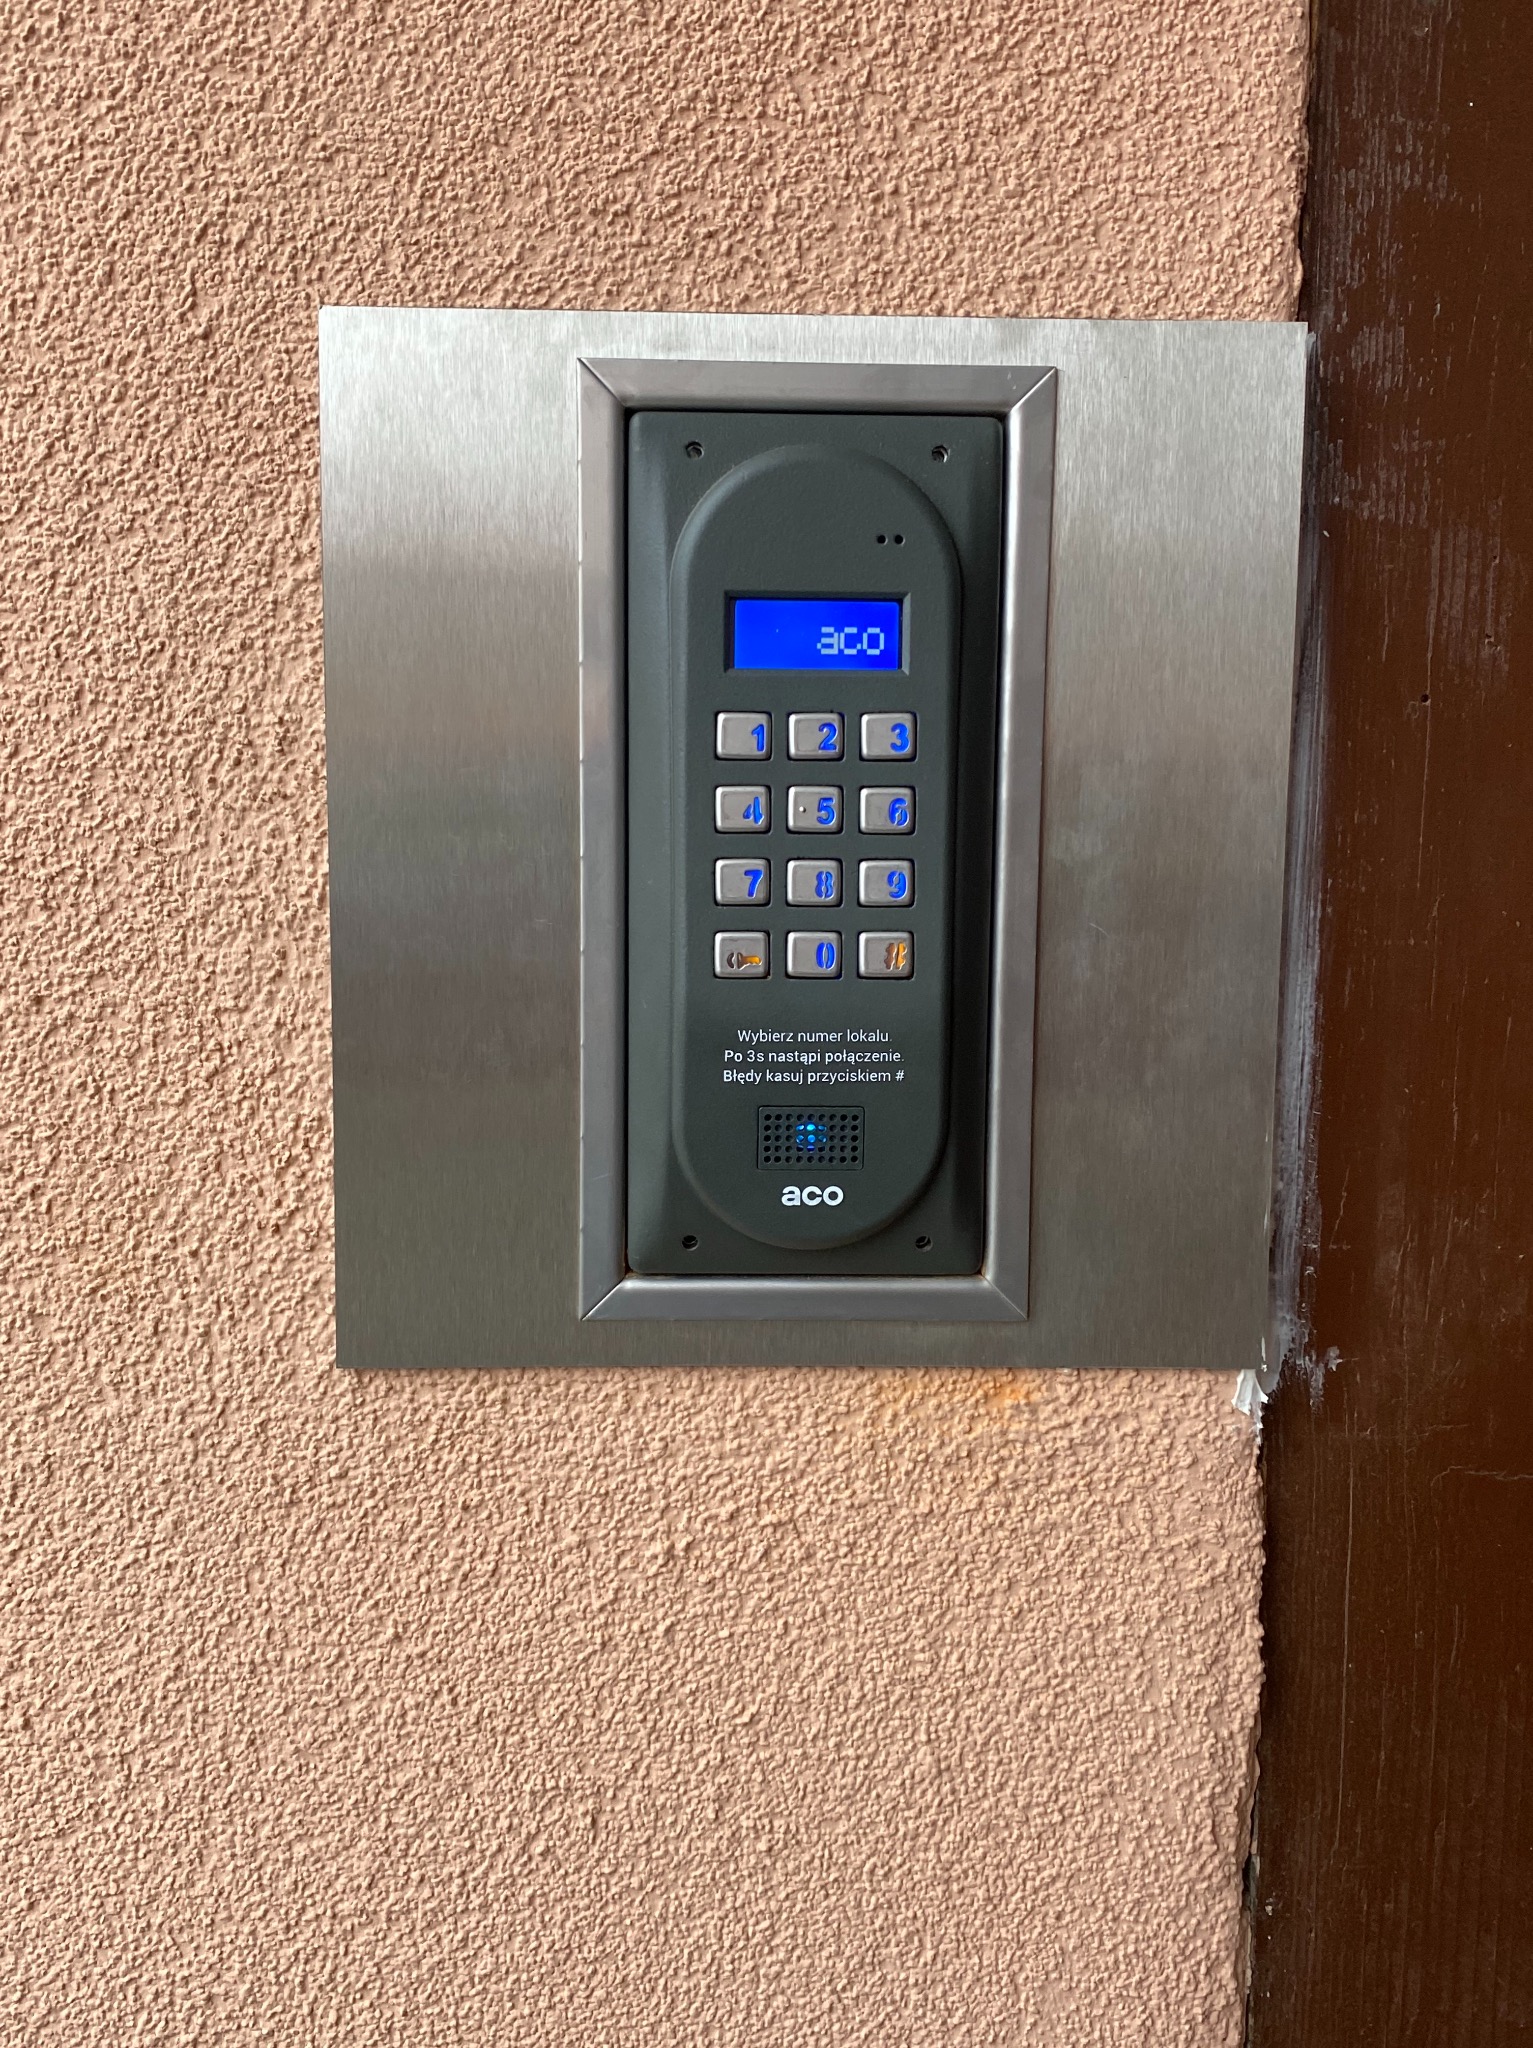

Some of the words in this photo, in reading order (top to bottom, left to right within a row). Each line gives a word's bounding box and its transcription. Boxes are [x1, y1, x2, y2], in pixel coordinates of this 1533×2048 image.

[816, 626, 885, 656] aco
[751, 723, 766, 753] 1
[818, 722, 838, 753] 2
[890, 722, 910, 753] 3
[743, 796, 764, 825] 4
[817, 797, 836, 826] 5
[888, 797, 909, 827] 6
[744, 868, 764, 898] 7
[815, 870, 834, 900] 8
[886, 870, 908, 900] 9
[815, 941, 837, 970] 0
[737, 1028, 794, 1046] Wybierz
[797, 1032, 844, 1042] numer
[846, 1028, 893, 1042] lokalu.
[724, 1049, 743, 1062] Po
[746, 1049, 765, 1062] 3s
[768, 1049, 821, 1065] nastąpi
[825, 1048, 905, 1065] połączenie.
[723, 1068, 763, 1085] Błędy
[766, 1068, 804, 1085] kasuj
[807, 1068, 891, 1085] przyciskiem
[895, 1069, 905, 1082] #
[781, 1185, 844, 1206] aco
